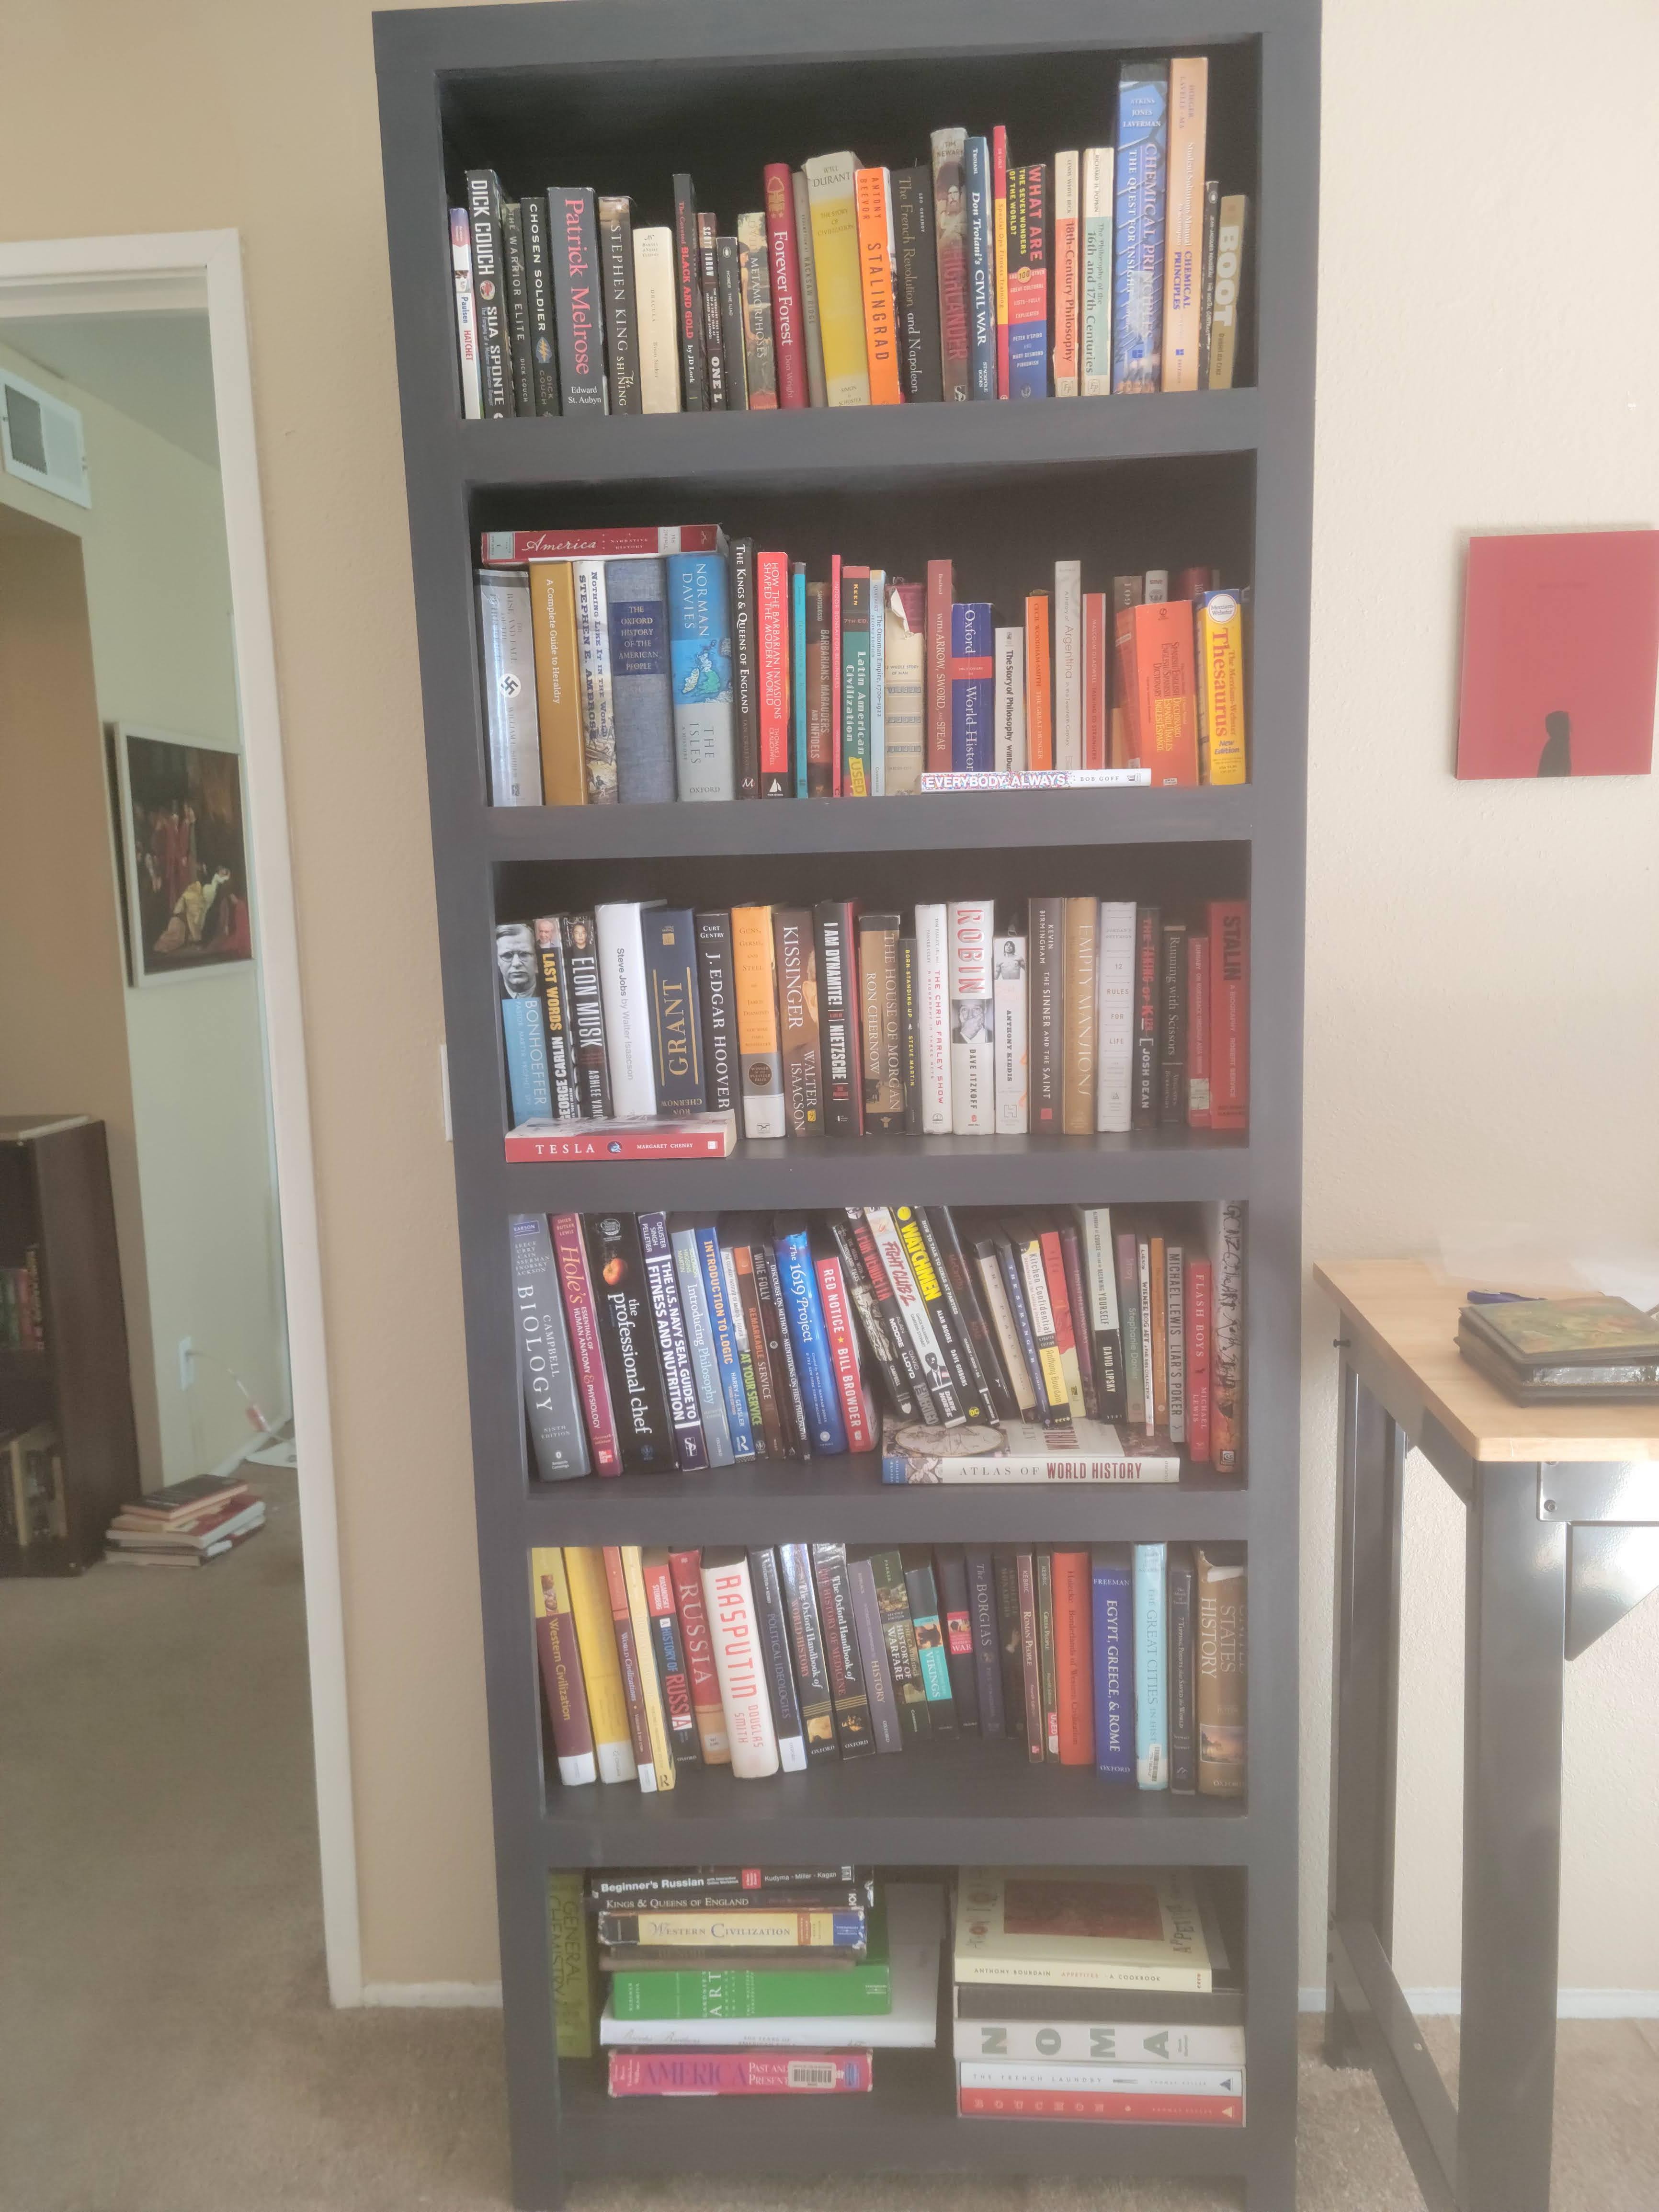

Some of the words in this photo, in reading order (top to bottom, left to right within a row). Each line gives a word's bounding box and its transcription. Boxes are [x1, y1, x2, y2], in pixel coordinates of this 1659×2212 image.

[1010, 171, 1015, 182] OF
[1028, 167, 1042, 218] WHAT
[471, 180, 490, 217] DICK
[972, 192, 980, 216] Don
[474, 222, 495, 275] COUCH
[529, 204, 541, 263] CHOSEN
[564, 199, 588, 277] Patrick
[973, 218, 981, 265] Troiani's
[1030, 227, 1043, 262] ARE
[611, 225, 625, 301] STEPHEN
[680, 246, 690, 284] BLACK
[773, 231, 787, 292] Forever
[1063, 222, 1075, 294] 18th-Century
[534, 270, 546, 331] SOLDIER
[683, 286, 692, 308] AND
[867, 243, 889, 360] STALINGRAD
[487, 306, 499, 339] SUA
[571, 286, 592, 375] Melrose
[615, 309, 628, 351] KING
[684, 310, 693, 339] GOLD
[779, 295, 793, 346] Forest
[1063, 299, 1074, 362] Philosophy
[464, 330, 473, 361] HATCHET
[490, 344, 505, 406] SPONTE
[571, 386, 597, 394] Edward
[616, 356, 626, 406] SHINING
[580, 396, 601, 404] Aubyn
[521, 534, 597, 551] America
[682, 573, 694, 629] DAVIES
[696, 563, 709, 636] NORMAN
[546, 588, 556, 628] Complete
[552, 665, 560, 704] Heraldry
[966, 610, 976, 654] Oxford
[579, 575, 590, 646] STEPHEN
[586, 669, 596, 739] AMBROSE
[857, 651, 866, 686] Latin
[847, 664, 855, 741] Civilization
[1213, 627, 1228, 737] Thesaurus
[690, 723, 701, 764] ISLES
[704, 726, 715, 758] THE
[858, 691, 867, 755] American
[851, 761, 864, 793] USED
[926, 775, 1004, 788] EVERYBODY
[1012, 774, 1066, 787] ALWAYS
[824, 929, 838, 946] AM
[957, 910, 985, 994] ROBIN
[542, 953, 556, 983] LAST
[572, 957, 597, 996] ELON
[705, 953, 720, 965] J.
[784, 926, 803, 1029] KISSINGER
[825, 949, 842, 1005] DYNAMITE!
[619, 973, 627, 997] Jobs
[621, 999, 628, 1009] by
[709, 969, 725, 1028] EDGAR
[547, 987, 562, 1031] WORDS
[575, 1002, 602, 1048] MUSK
[623, 1011, 631, 1039] Walter
[662, 980, 688, 1075] GRANT
[525, 1000, 546, 1105] BONHOEFFER
[625, 1041, 634, 1080] Isaacson
[714, 1037, 730, 1109] HOOVER
[830, 1026, 847, 1079] NIETZSCHE
[535, 1144, 596, 1154] TESLA
[661, 1261, 673, 1283] THE
[789, 1245, 797, 1261] The
[901, 1221, 942, 1302] WATCHMEN
[561, 1245, 583, 1304] Hole's
[648, 1265, 664, 1318] FITNESS
[790, 1264, 805, 1294] 1619
[823, 1269, 835, 1290] RED
[1169, 1254, 1181, 1300] MICHAEL
[628, 1299, 637, 1316] the
[827, 1296, 844, 1334] NOTICE
[1196, 1275, 1204, 1317] FLASH
[657, 1321, 671, 1348] AND
[670, 1308, 682, 1337] NAVY
[797, 1298, 812, 1343] Project
[1170, 1304, 1181, 1335] LEWIS
[518, 1286, 552, 1411] BIOLOGY
[542, 1315, 560, 1378] CAMPBELL
[674, 1340, 687, 1367] SEAL
[838, 1348, 849, 1372] BILL
[1170, 1345, 1181, 1378] LIAR'S
[1196, 1325, 1204, 1357] BOYS
[608, 1293, 645, 1394] professional
[630, 1398, 652, 1434] chef
[663, 1351, 685, 1421] NUTRITION
[680, 1368, 693, 1403] GUIDE
[842, 1375, 861, 1428] BROWDER
[1170, 1383, 1182, 1416] POKER
[686, 1403, 697, 1419] TO
[960, 1467, 1011, 1476] ATLAS
[1046, 1462, 1086, 1479] WORLD
[1092, 1462, 1142, 1479] HISTORY
[680, 1585, 712, 1684] RUSSIA
[977, 1584, 992, 1645] BORGIAS
[1107, 1600, 1117, 1643] EGYPT,
[715, 1575, 758, 1699] RASPUTIN
[548, 1618, 562, 1665] Western
[555, 1665, 571, 1720] Civilization
[1108, 1646, 1119, 1697] GREECE,
[1109, 1702, 1119, 1710] &
[845, 1739, 868, 1749] OXFORD
[1109, 1714, 1120, 1752] ROME
[601, 1880, 659, 1893] Beginner's
[662, 1877, 704, 1890] Russian
[638, 1899, 647, 1907] &
